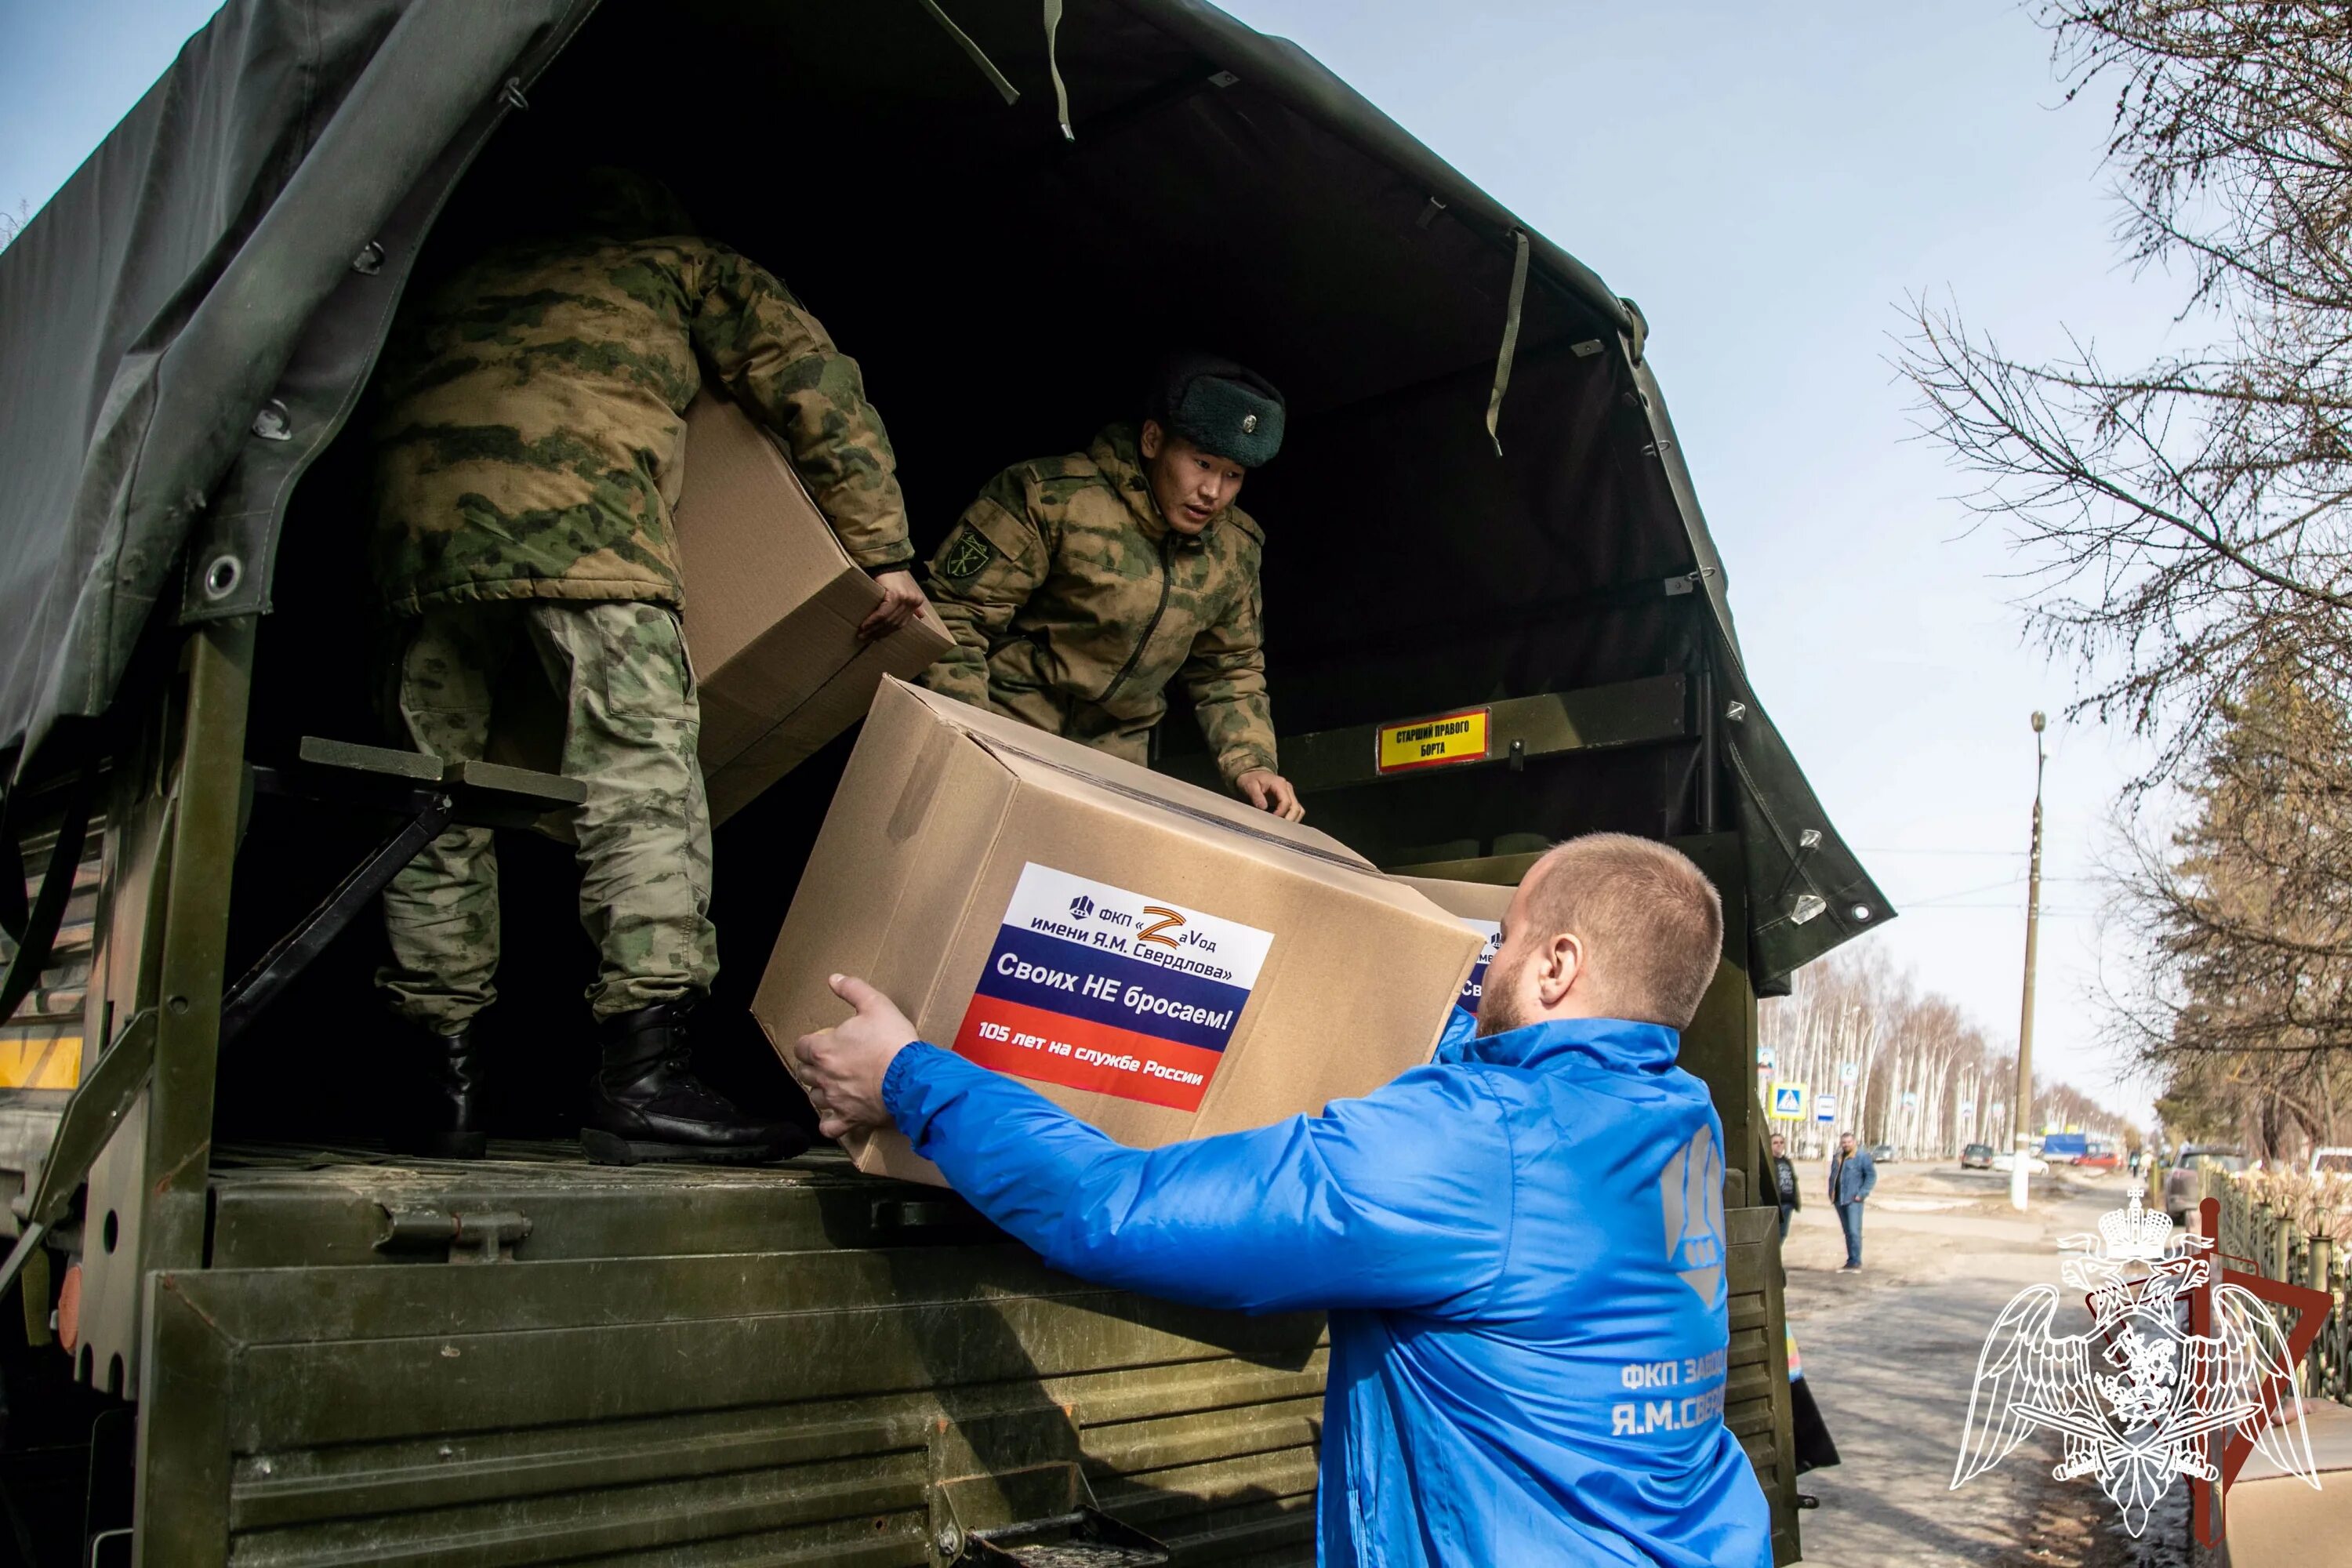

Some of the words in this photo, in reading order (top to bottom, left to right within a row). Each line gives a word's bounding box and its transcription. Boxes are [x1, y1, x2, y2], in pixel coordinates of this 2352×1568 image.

[1396, 723, 1433, 743] СТАРШИЙ
[1435, 720, 1469, 738] ПРАВОГО
[1421, 742, 1445, 757] БОРТА
[1099, 908, 1133, 927] ФКП
[1030, 916, 1090, 942] имени
[1092, 931, 1127, 953] Я.М.
[1133, 942, 1232, 982] Свердлова»
[996, 953, 1079, 992] Своих
[1082, 974, 1122, 1003] НЕ
[1123, 985, 1234, 1031] бросаем!
[978, 1022, 1011, 1043] 105
[1011, 1032, 1047, 1051] лет
[1048, 1040, 1072, 1057] на
[1074, 1046, 1141, 1073] службе
[1142, 1060, 1204, 1087] России
[1621, 1361, 1678, 1390] ФКП
